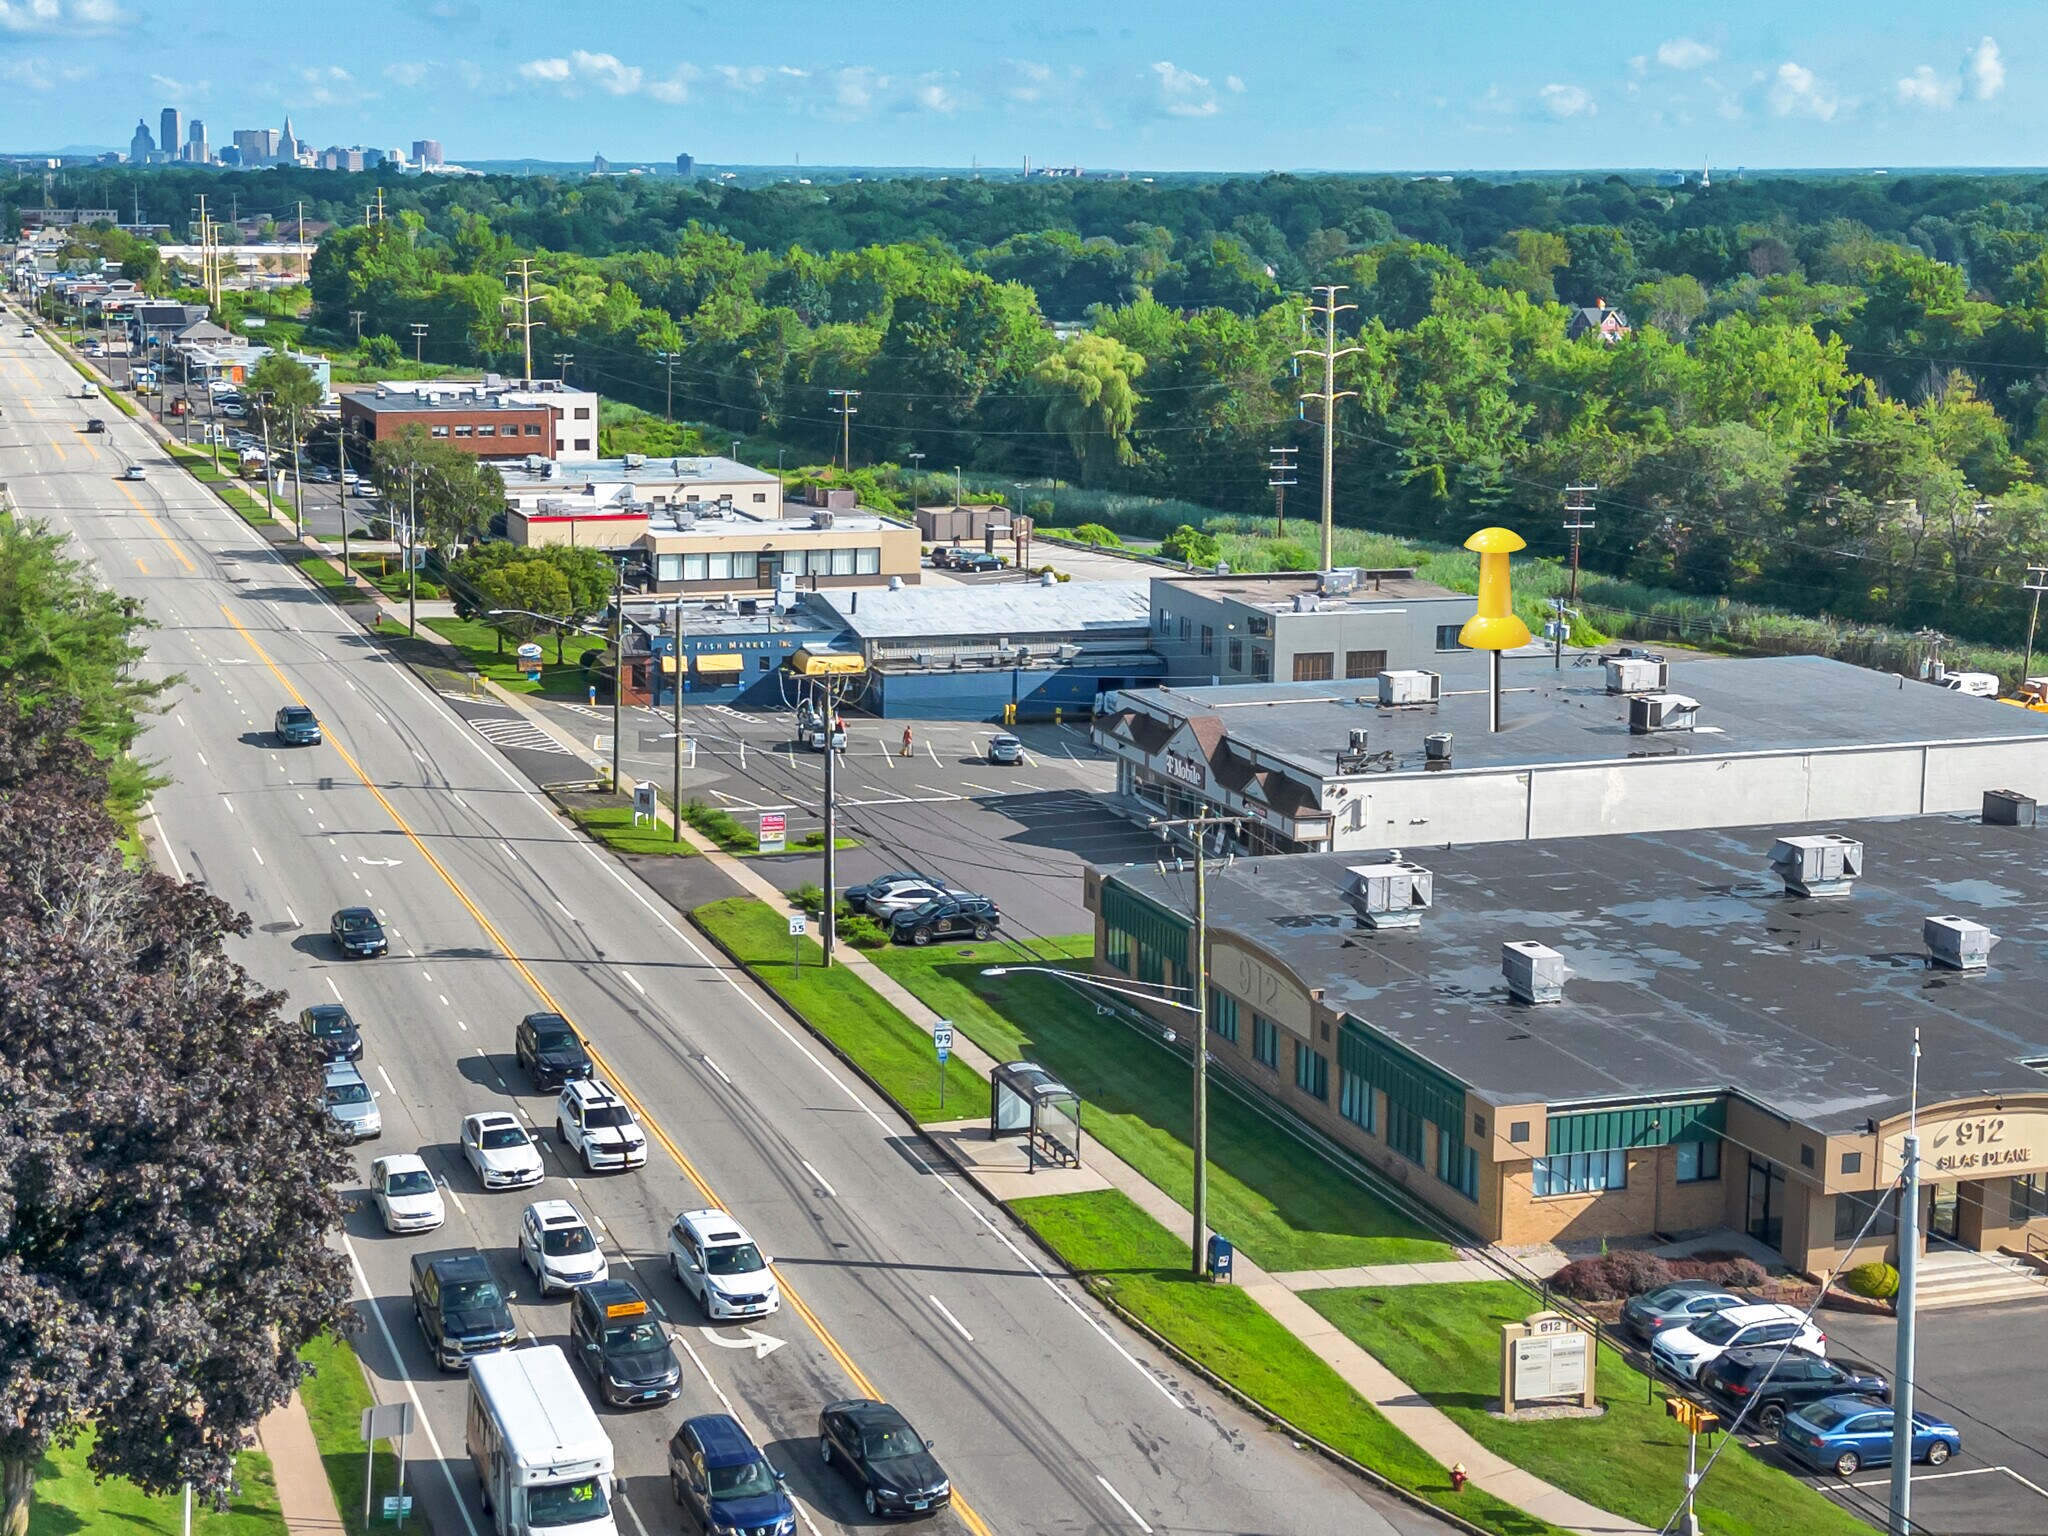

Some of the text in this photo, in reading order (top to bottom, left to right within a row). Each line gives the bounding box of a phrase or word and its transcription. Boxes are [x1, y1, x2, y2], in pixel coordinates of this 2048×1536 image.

[666, 643, 690, 651] CY
[696, 642, 722, 651] FISH
[728, 640, 772, 650] MARKET
[791, 925, 804, 933] 35
[1240, 956, 1278, 1013] 912
[936, 1033, 951, 1045] 99
[1955, 1118, 2004, 1147] 912
